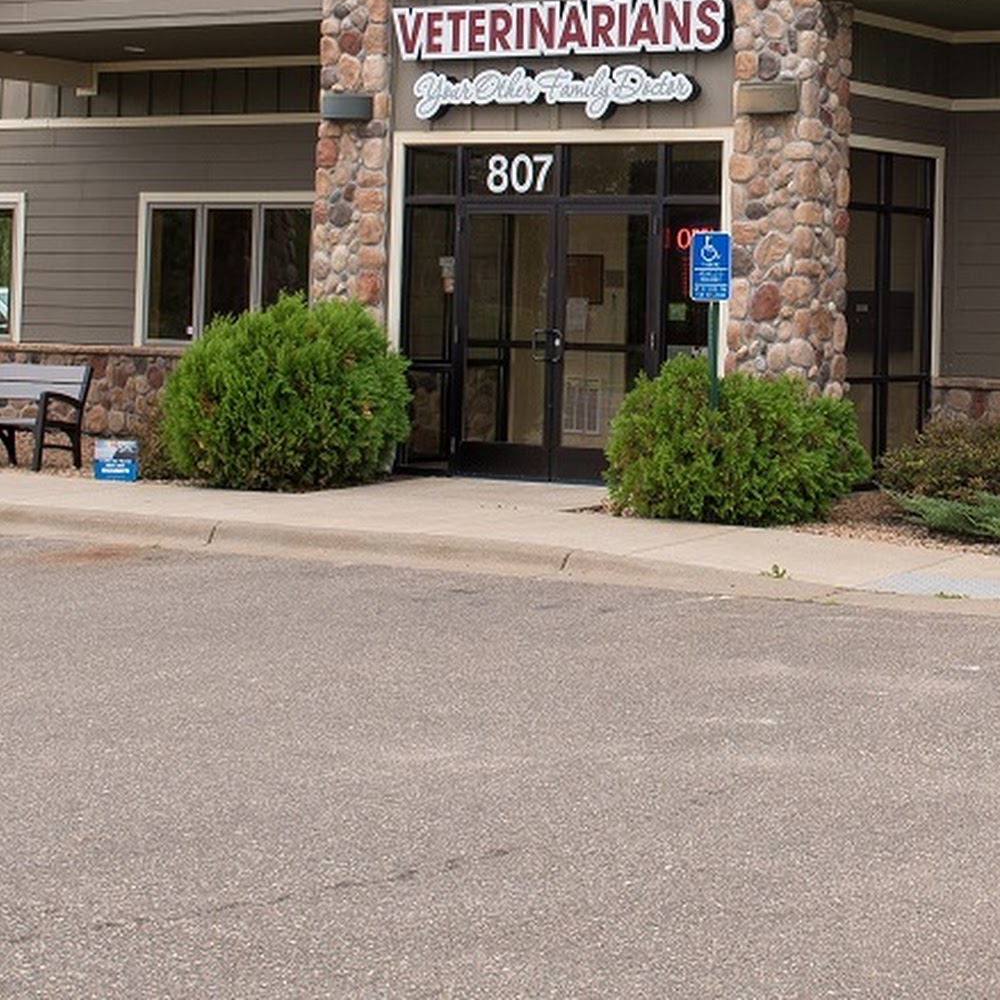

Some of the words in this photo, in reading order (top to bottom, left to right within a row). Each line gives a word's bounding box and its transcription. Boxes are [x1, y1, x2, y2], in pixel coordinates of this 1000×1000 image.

[396, 0, 725, 55] VETERINARIANS
[417, 73, 473, 116] Your
[473, 69, 536, 103] Other
[537, 67, 612, 116] Family
[612, 68, 692, 102] Doctor
[486, 153, 554, 194] 807
